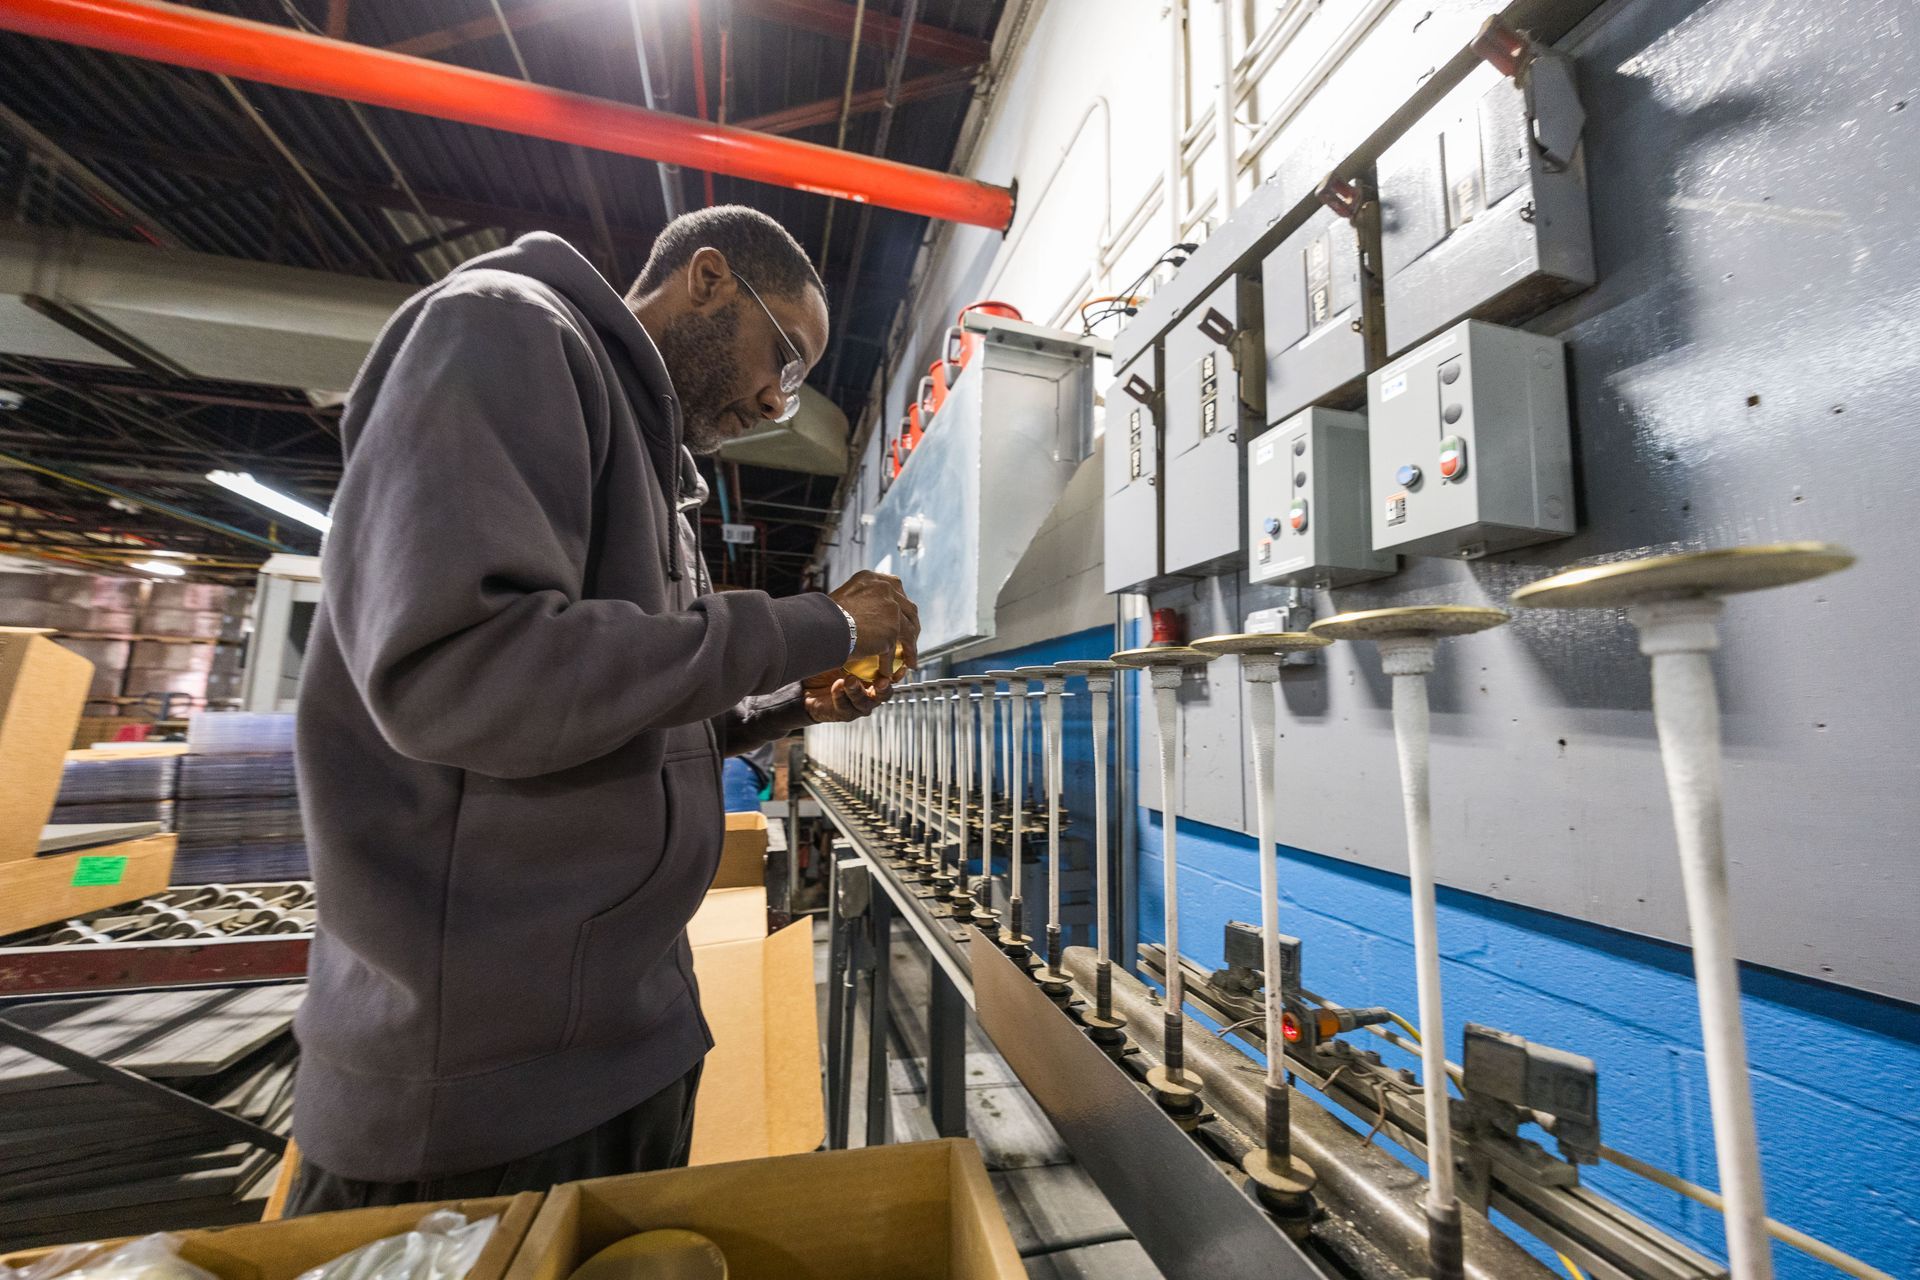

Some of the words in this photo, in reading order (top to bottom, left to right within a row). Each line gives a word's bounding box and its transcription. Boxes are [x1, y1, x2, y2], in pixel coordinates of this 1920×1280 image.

[1314, 290, 1325, 321] OFF
[1204, 357, 1213, 379] ON
[1204, 402, 1214, 433] OFF
[1132, 451, 1140, 477] OFF
